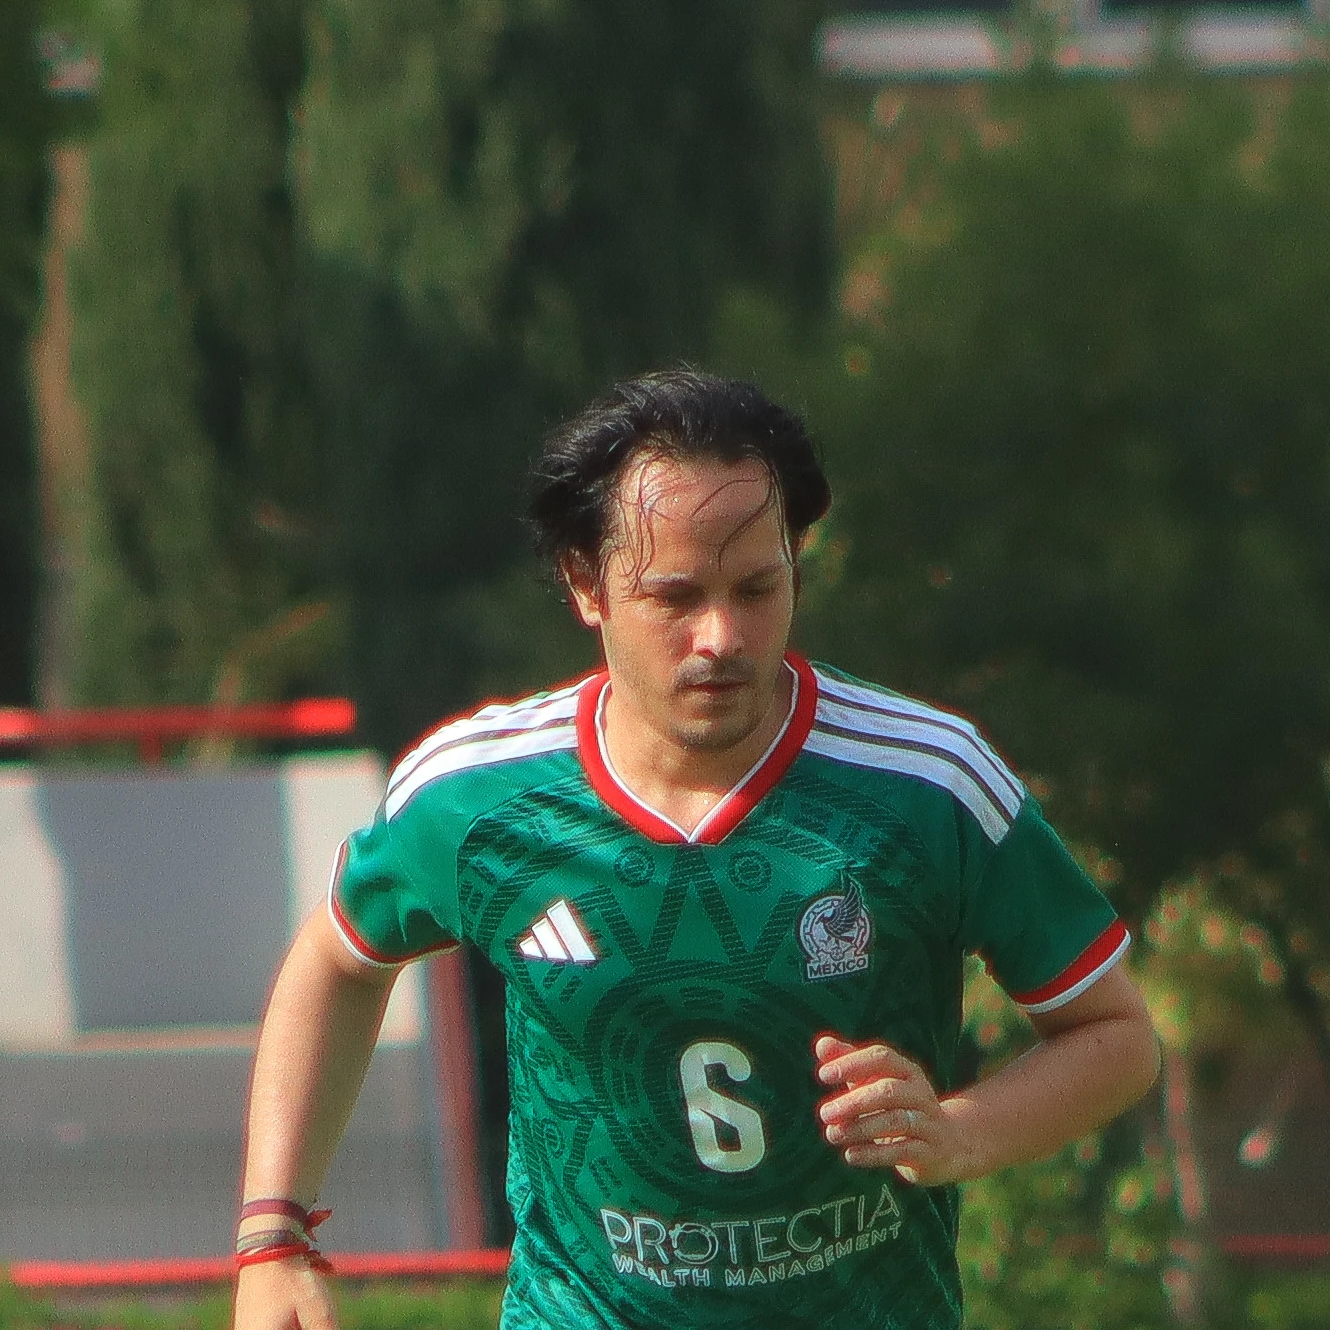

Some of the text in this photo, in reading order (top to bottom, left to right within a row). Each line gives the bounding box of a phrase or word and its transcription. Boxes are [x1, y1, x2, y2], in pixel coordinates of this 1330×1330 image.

[808, 957, 867, 977] MÉXICO
[679, 1041, 766, 1173] 6
[600, 1184, 900, 1266] PROTECTIA
[724, 1220, 902, 1287] MANAGEMENT
